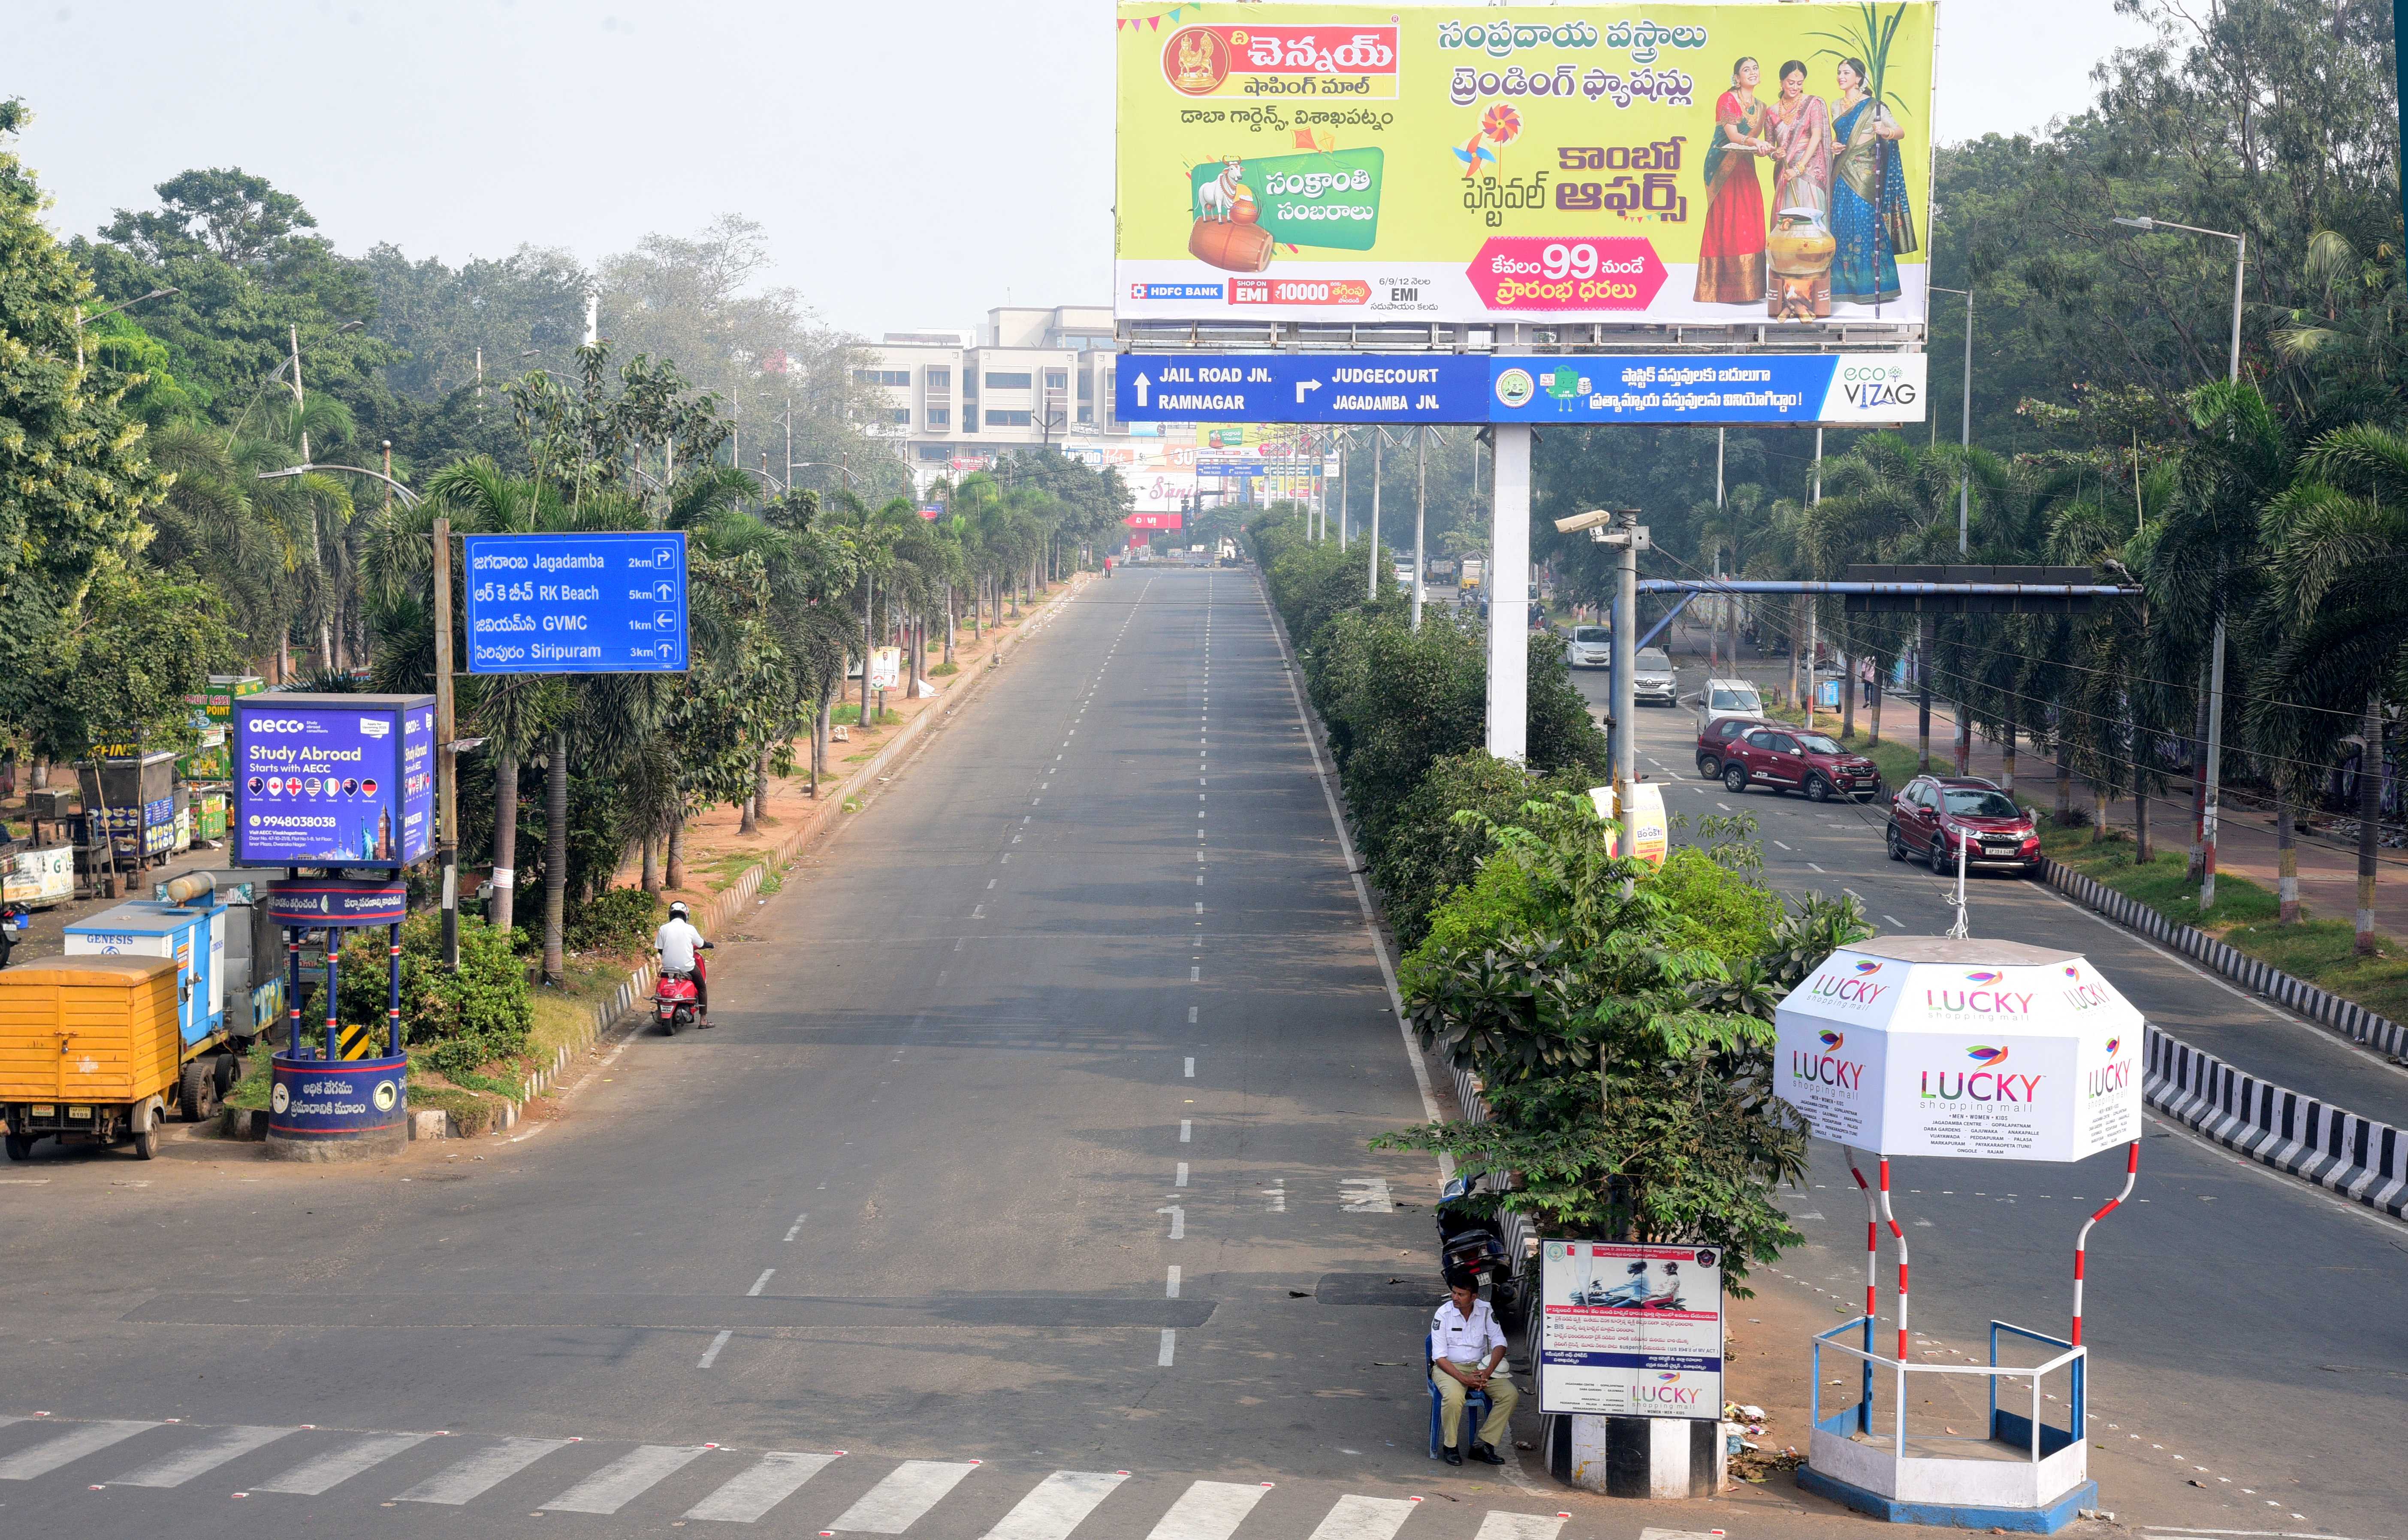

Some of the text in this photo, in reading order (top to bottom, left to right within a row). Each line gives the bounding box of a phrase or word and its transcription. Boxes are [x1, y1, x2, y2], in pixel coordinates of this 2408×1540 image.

[1231, 30, 1249, 44] ది
[1438, 20, 1708, 63] సంప్రదాయ వస్త్రాలు
[1244, 77, 1370, 96] షాపింగ్ మాల్
[1450, 65, 1693, 108] ట్రెండింగ్ ఫ్యాషన్లు
[1181, 105, 1393, 132] డాబా గార్డెన్స్, విశాఖపట్నం
[1557, 136, 1687, 172] కాంబో
[1266, 169, 1372, 198] సంక్రాంతి
[1461, 171, 1687, 227] ఫెస్టివల్ ఆఫర్స్
[1277, 202, 1373, 220] సంబరాలు
[1491, 244, 1644, 279] కేవలం 99 నుండే
[1379, 277, 1408, 286] 6/9/12
[1151, 288, 1182, 296] HDFC
[1237, 288, 1268, 301] EMI
[1331, 286, 1365, 298] తగ్గింపు
[1391, 288, 1418, 301] EMI
[1496, 277, 1637, 304] ప్రారంభ ధరలు
[1371, 303, 1414, 311] సదుపాయం
[1159, 368, 1272, 383] JAIL ROAD JN.
[1332, 368, 1439, 383] JUDGECOURT
[1622, 367, 1770, 388] ప్లాస్టిక్ వస్తువులకు బదులుగా
[1159, 395, 1244, 410] RAMNAGAR
[1334, 395, 1439, 410] JAGADAMBA JN.
[1590, 393, 1660, 412] ప్రత్యామ్నాయ
[1662, 392, 1721, 411] వస్తువులను
[1844, 383, 1916, 407] VIZAG
[474, 553, 652, 572] జగదాంబ Jagadamba 2km
[475, 582, 652, 602] ఆర్ కె బీచ్ RK Beach 5km
[543, 615, 587, 631] GVMC
[629, 621, 651, 630] 1km
[477, 644, 653, 662] సిరిపురం Siripuram 3km
[209, 695, 230, 705] LASSI
[206, 706, 230, 715] POINT
[249, 719, 304, 733] aecc
[250, 745, 361, 763] Study Abroad
[250, 763, 331, 773] Starts with AECC
[263, 816, 336, 827] 9948038038
[87, 934, 133, 945] GENESIS
[1811, 975, 1888, 1004] LUCKY
[2063, 982, 2110, 1010] LUCKY
[1807, 995, 1847, 1008] shopping
[1927, 990, 2034, 1013] LUCKY
[1928, 1013, 1993, 1021] shopping
[1794, 1051, 1863, 1090] LUCKY
[2089, 1058, 2130, 1098] LUCKY
[303, 1080, 352, 1097] అధిక వేగము
[1793, 1080, 1857, 1100] shopping mall
[1921, 1071, 2042, 1102] LUCKY
[291, 1100, 365, 1117] ప్రమాదానికి మూలం
[1920, 1100, 2031, 1112] shopping mall
[1632, 1386, 1699, 1403] LUCKY
